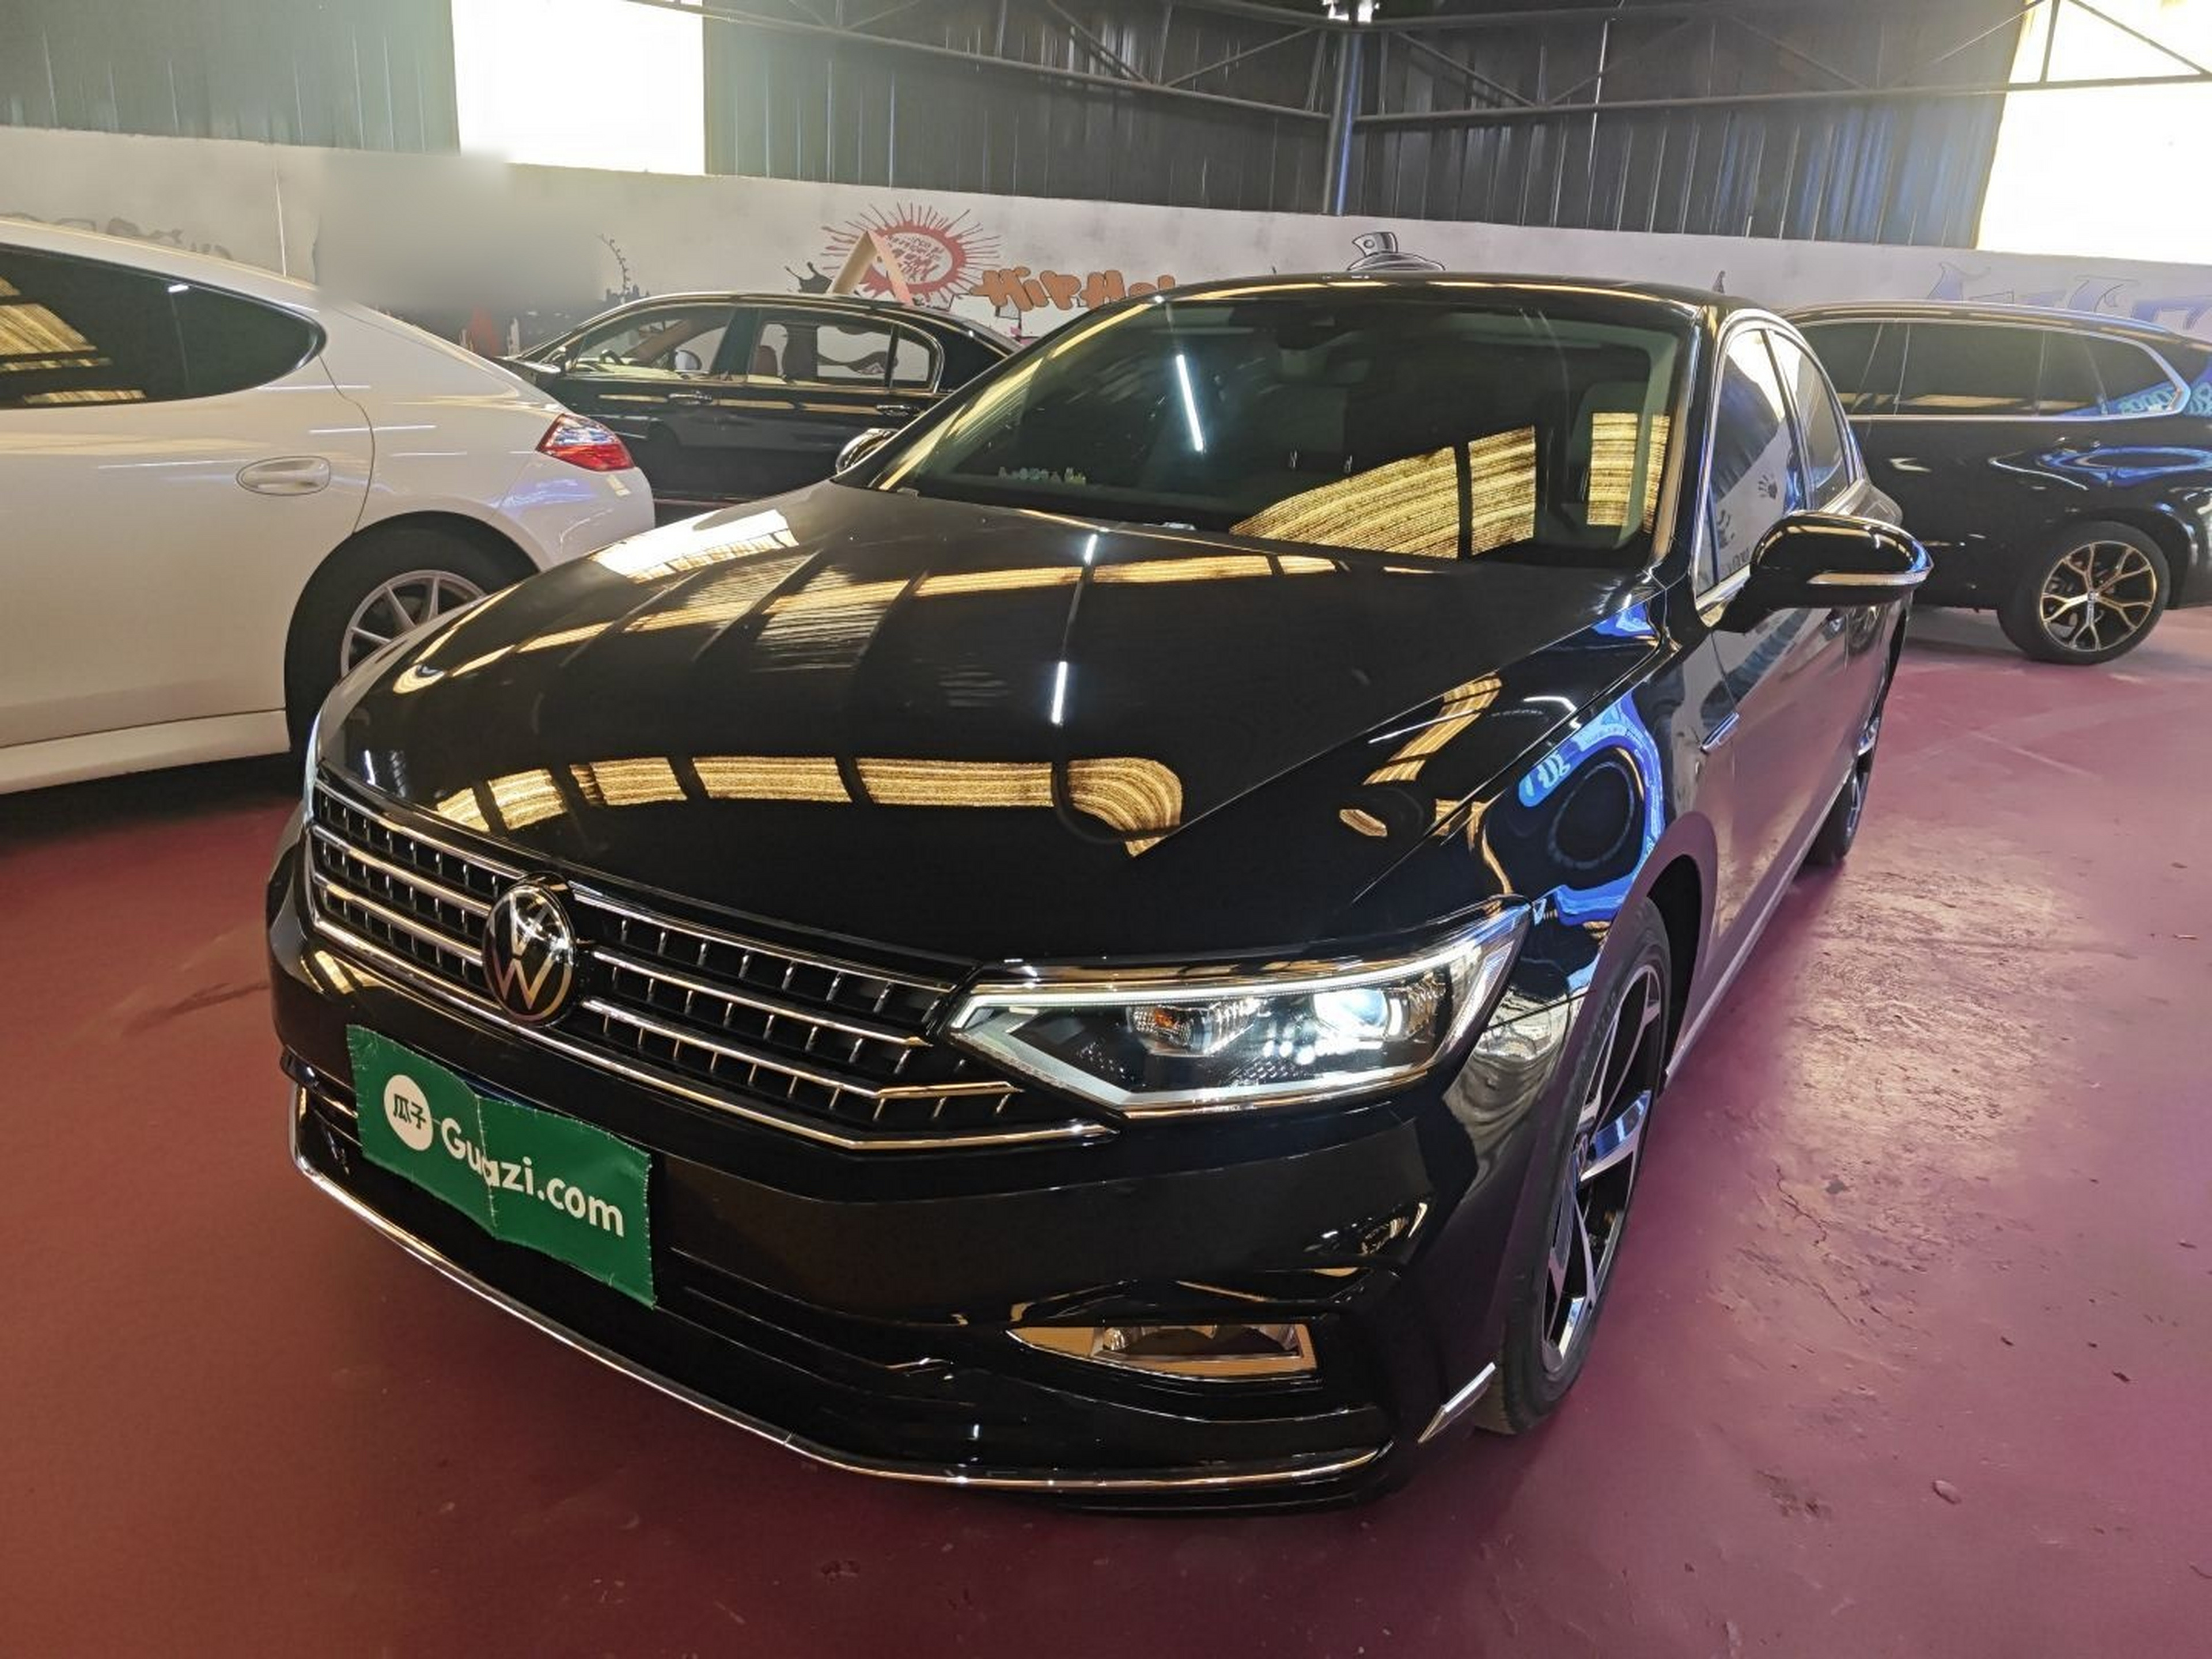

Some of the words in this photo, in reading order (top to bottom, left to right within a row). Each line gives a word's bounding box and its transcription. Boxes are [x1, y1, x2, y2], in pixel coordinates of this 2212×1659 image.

[488, 887, 572, 1016] VW
[392, 1093, 426, 1130] 瓜子
[440, 1118, 624, 1237] Guazi.com
